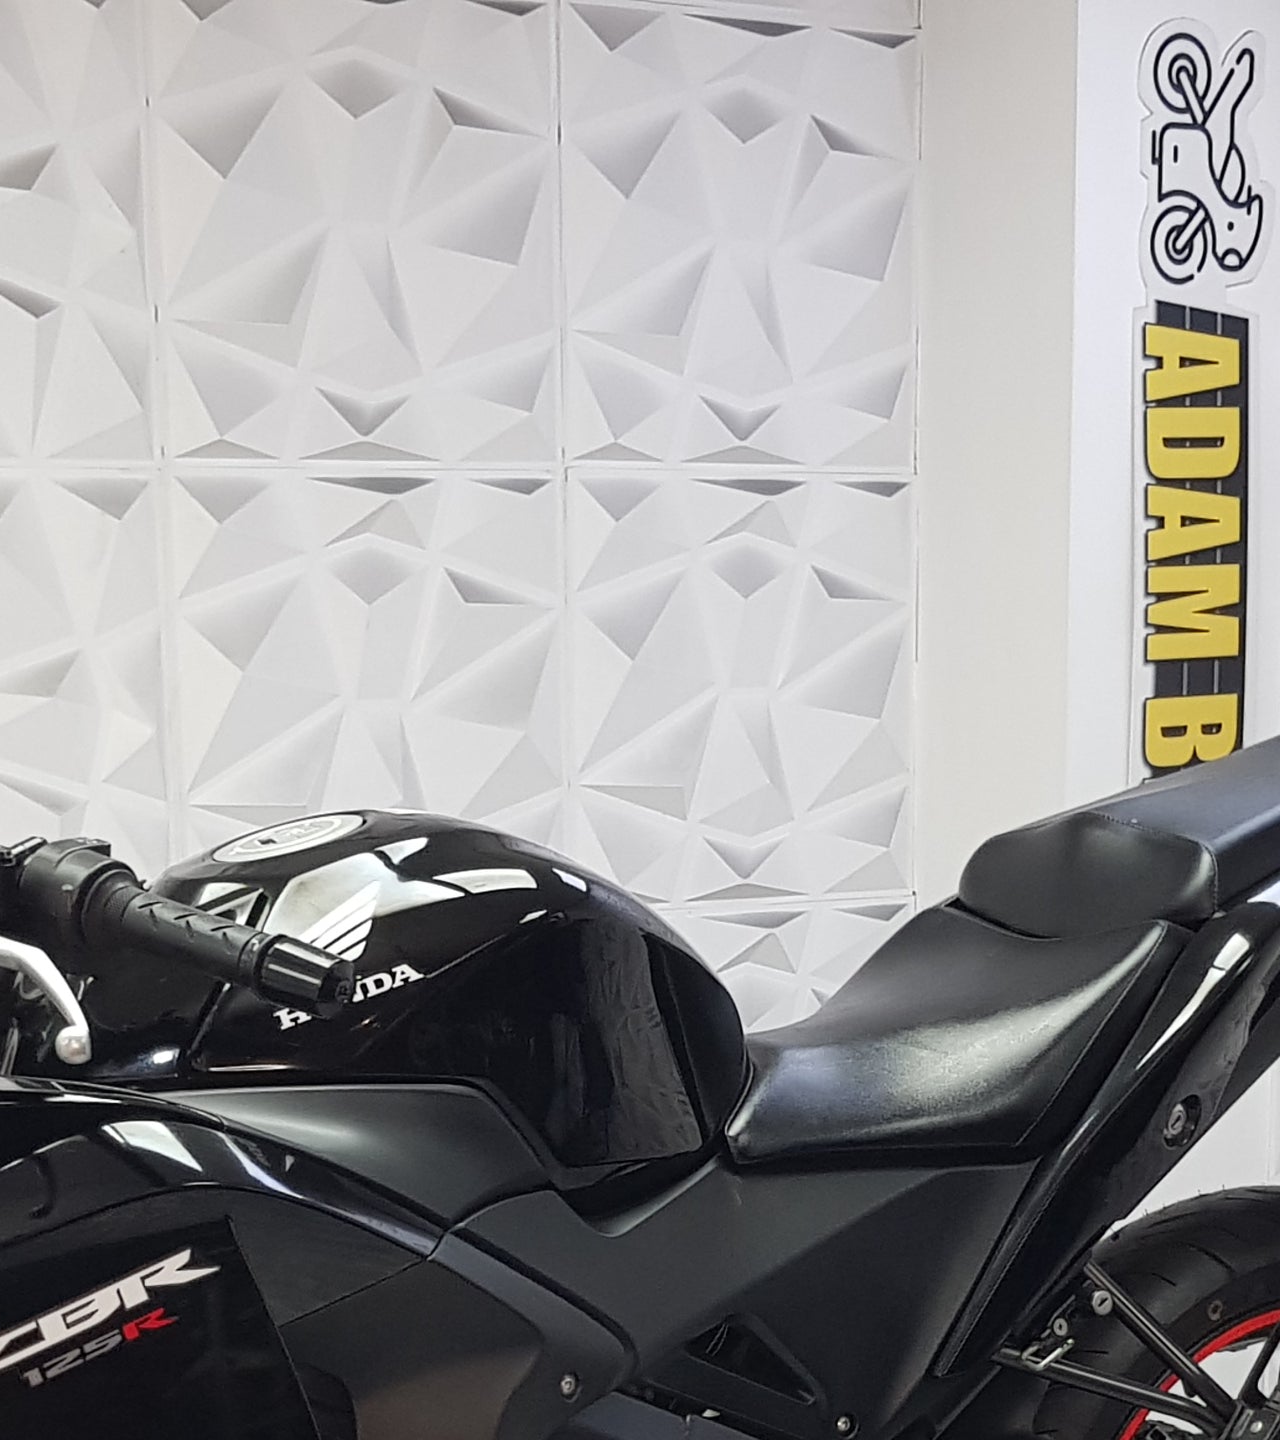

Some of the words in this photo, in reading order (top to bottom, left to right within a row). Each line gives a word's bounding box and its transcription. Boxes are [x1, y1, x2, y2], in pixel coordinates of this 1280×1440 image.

[1143, 322, 1241, 661] ADAM
[1143, 692, 1238, 769] B
[273, 963, 425, 1031] HDA
[23, 1307, 179, 1388] 125R
